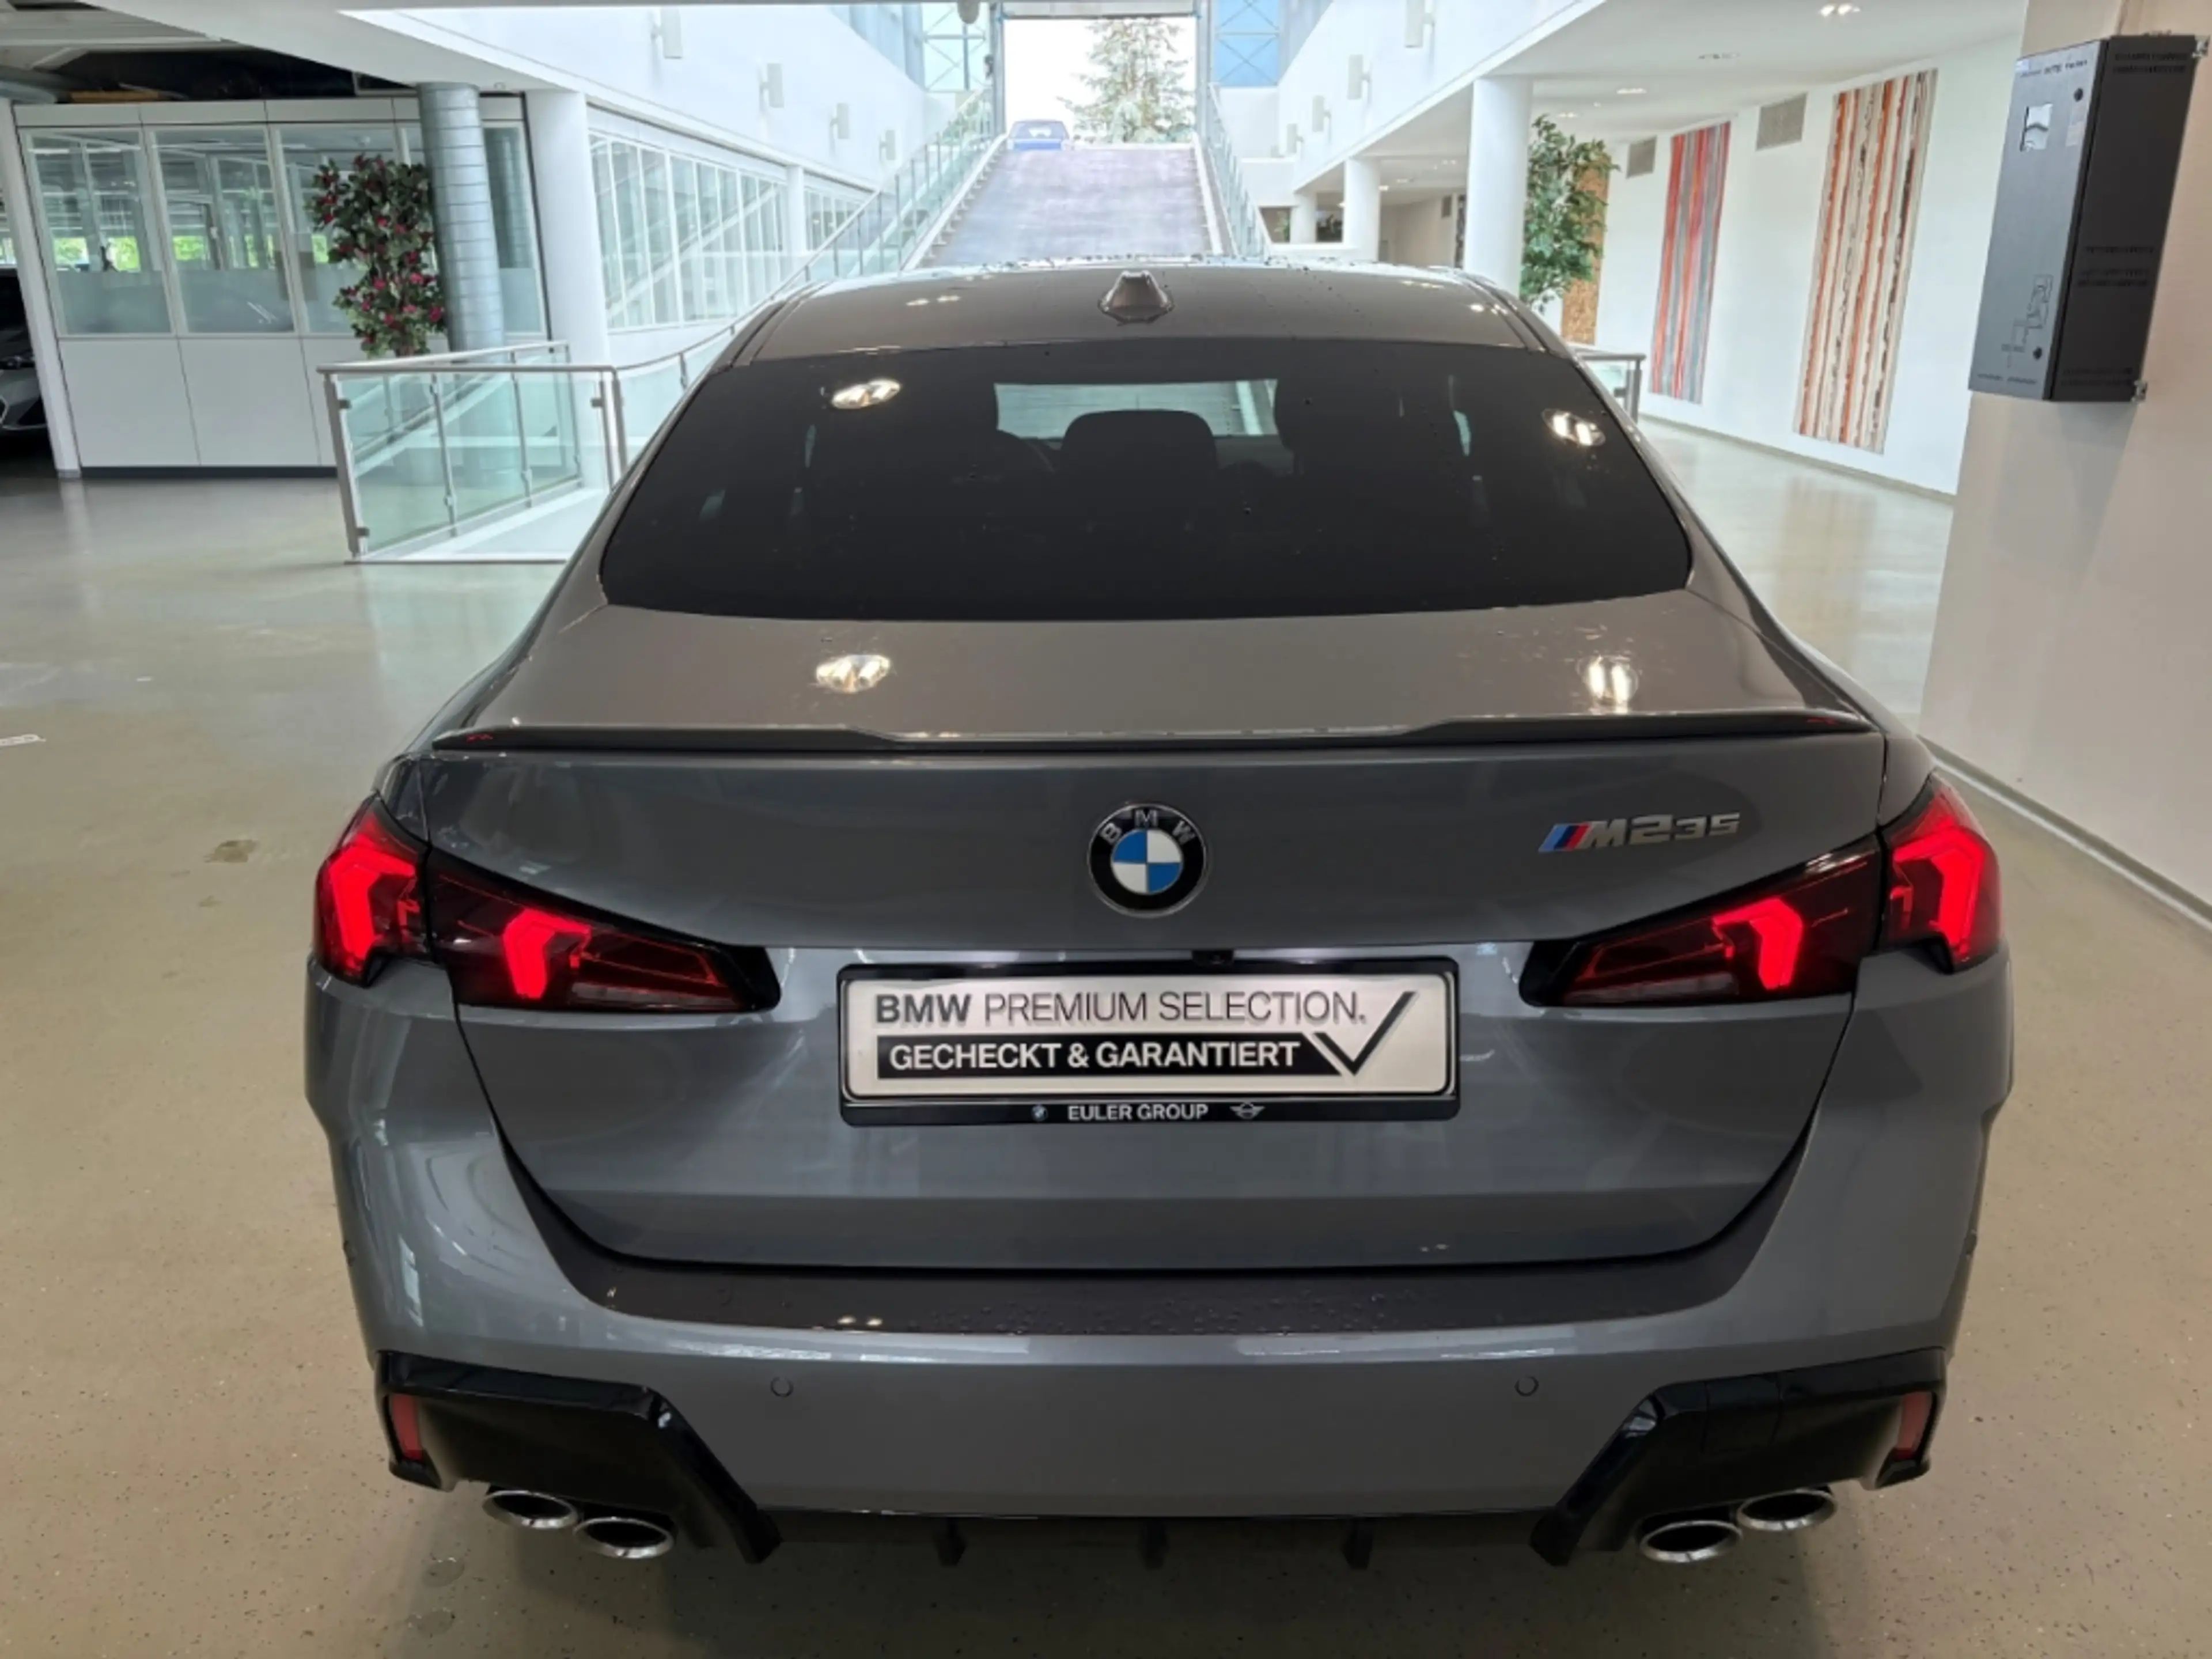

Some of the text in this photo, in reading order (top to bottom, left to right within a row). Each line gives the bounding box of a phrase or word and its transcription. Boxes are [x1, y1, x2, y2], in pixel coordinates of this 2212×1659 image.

[1099, 809, 1196, 845] BMW
[1576, 813, 1740, 850] M235
[876, 993, 972, 1024] BMW
[984, 991, 1147, 1022] PREMIUM
[889, 1041, 1301, 1071] GECHECKT & GARANTIERT
[1067, 1103, 1209, 1121] EULER GROUP
